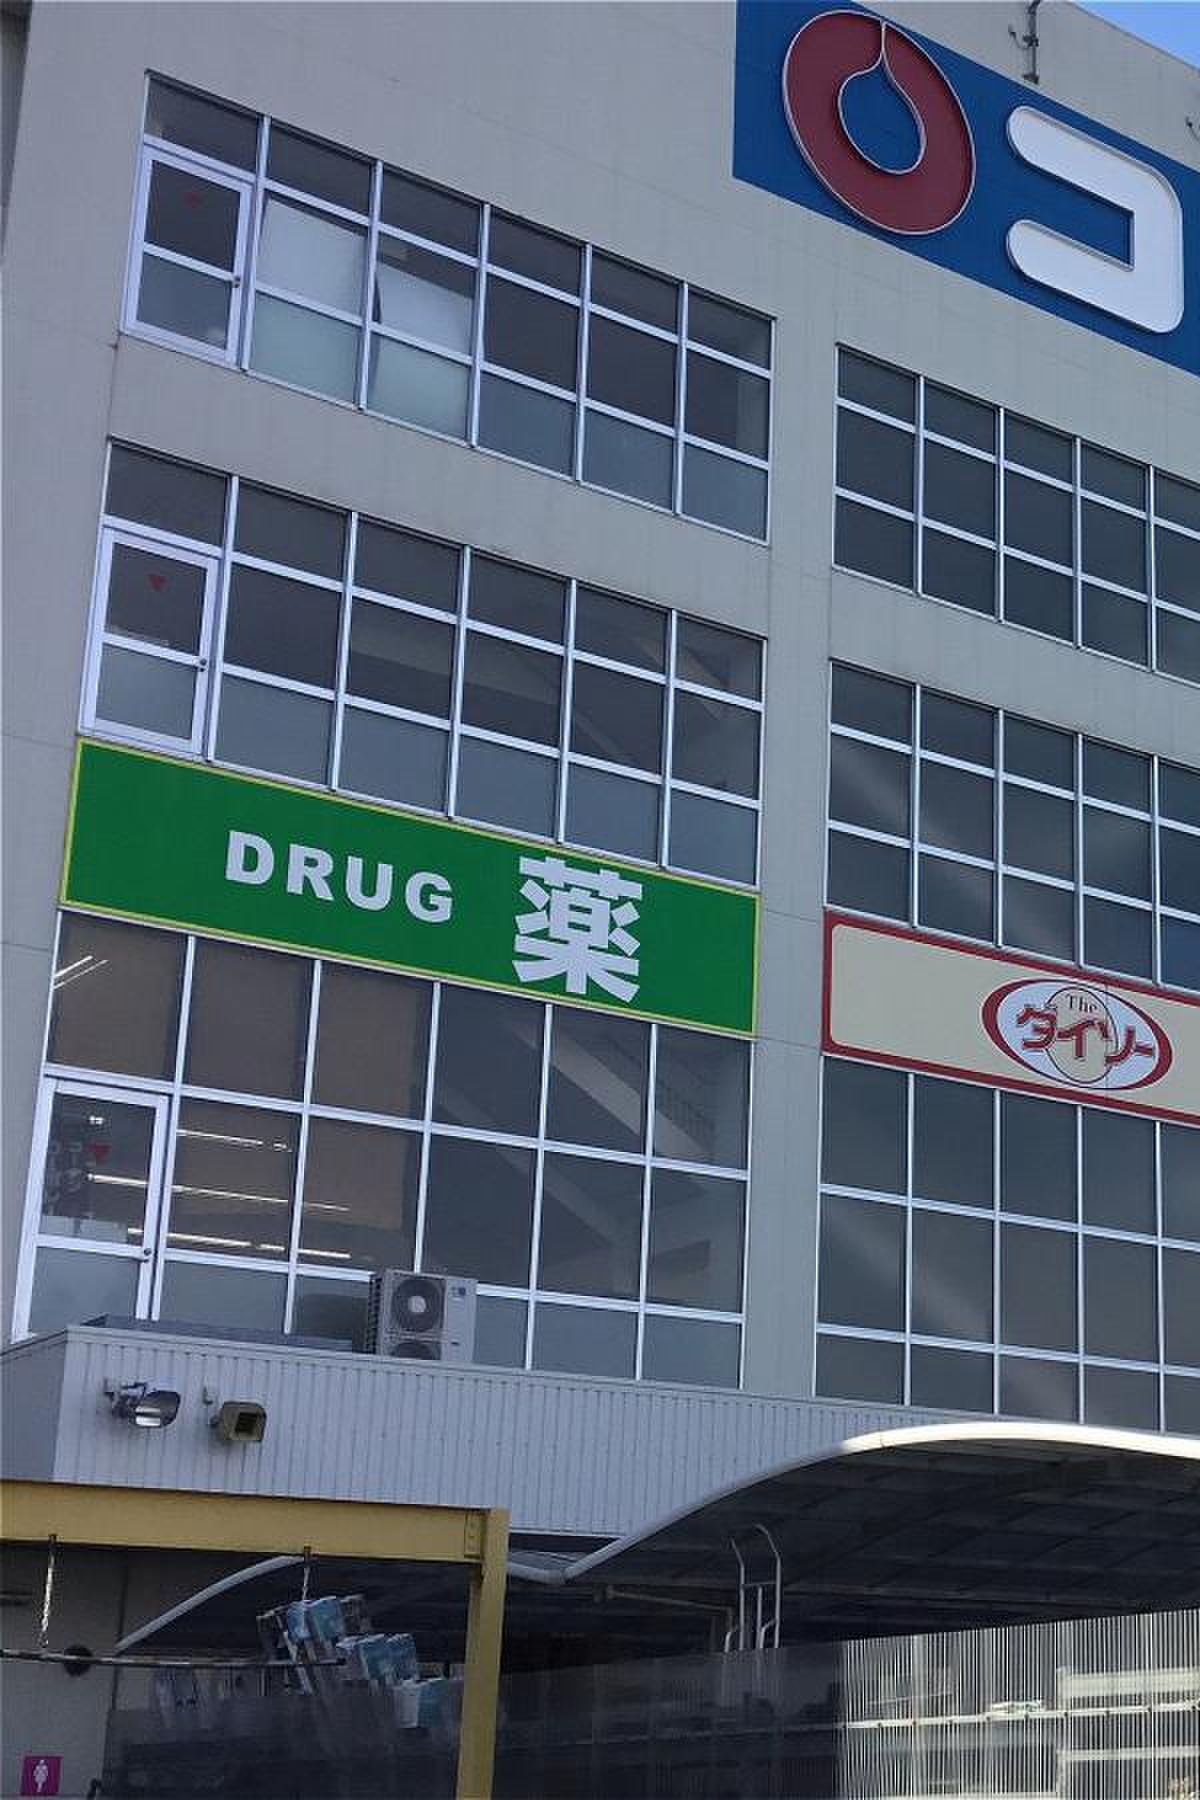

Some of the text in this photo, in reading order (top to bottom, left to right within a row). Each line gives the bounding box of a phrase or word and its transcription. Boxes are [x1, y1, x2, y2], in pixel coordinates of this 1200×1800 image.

[225, 830, 453, 924] DRUG
[511, 856, 643, 1002] 薬
[1066, 993, 1098, 1014] The
